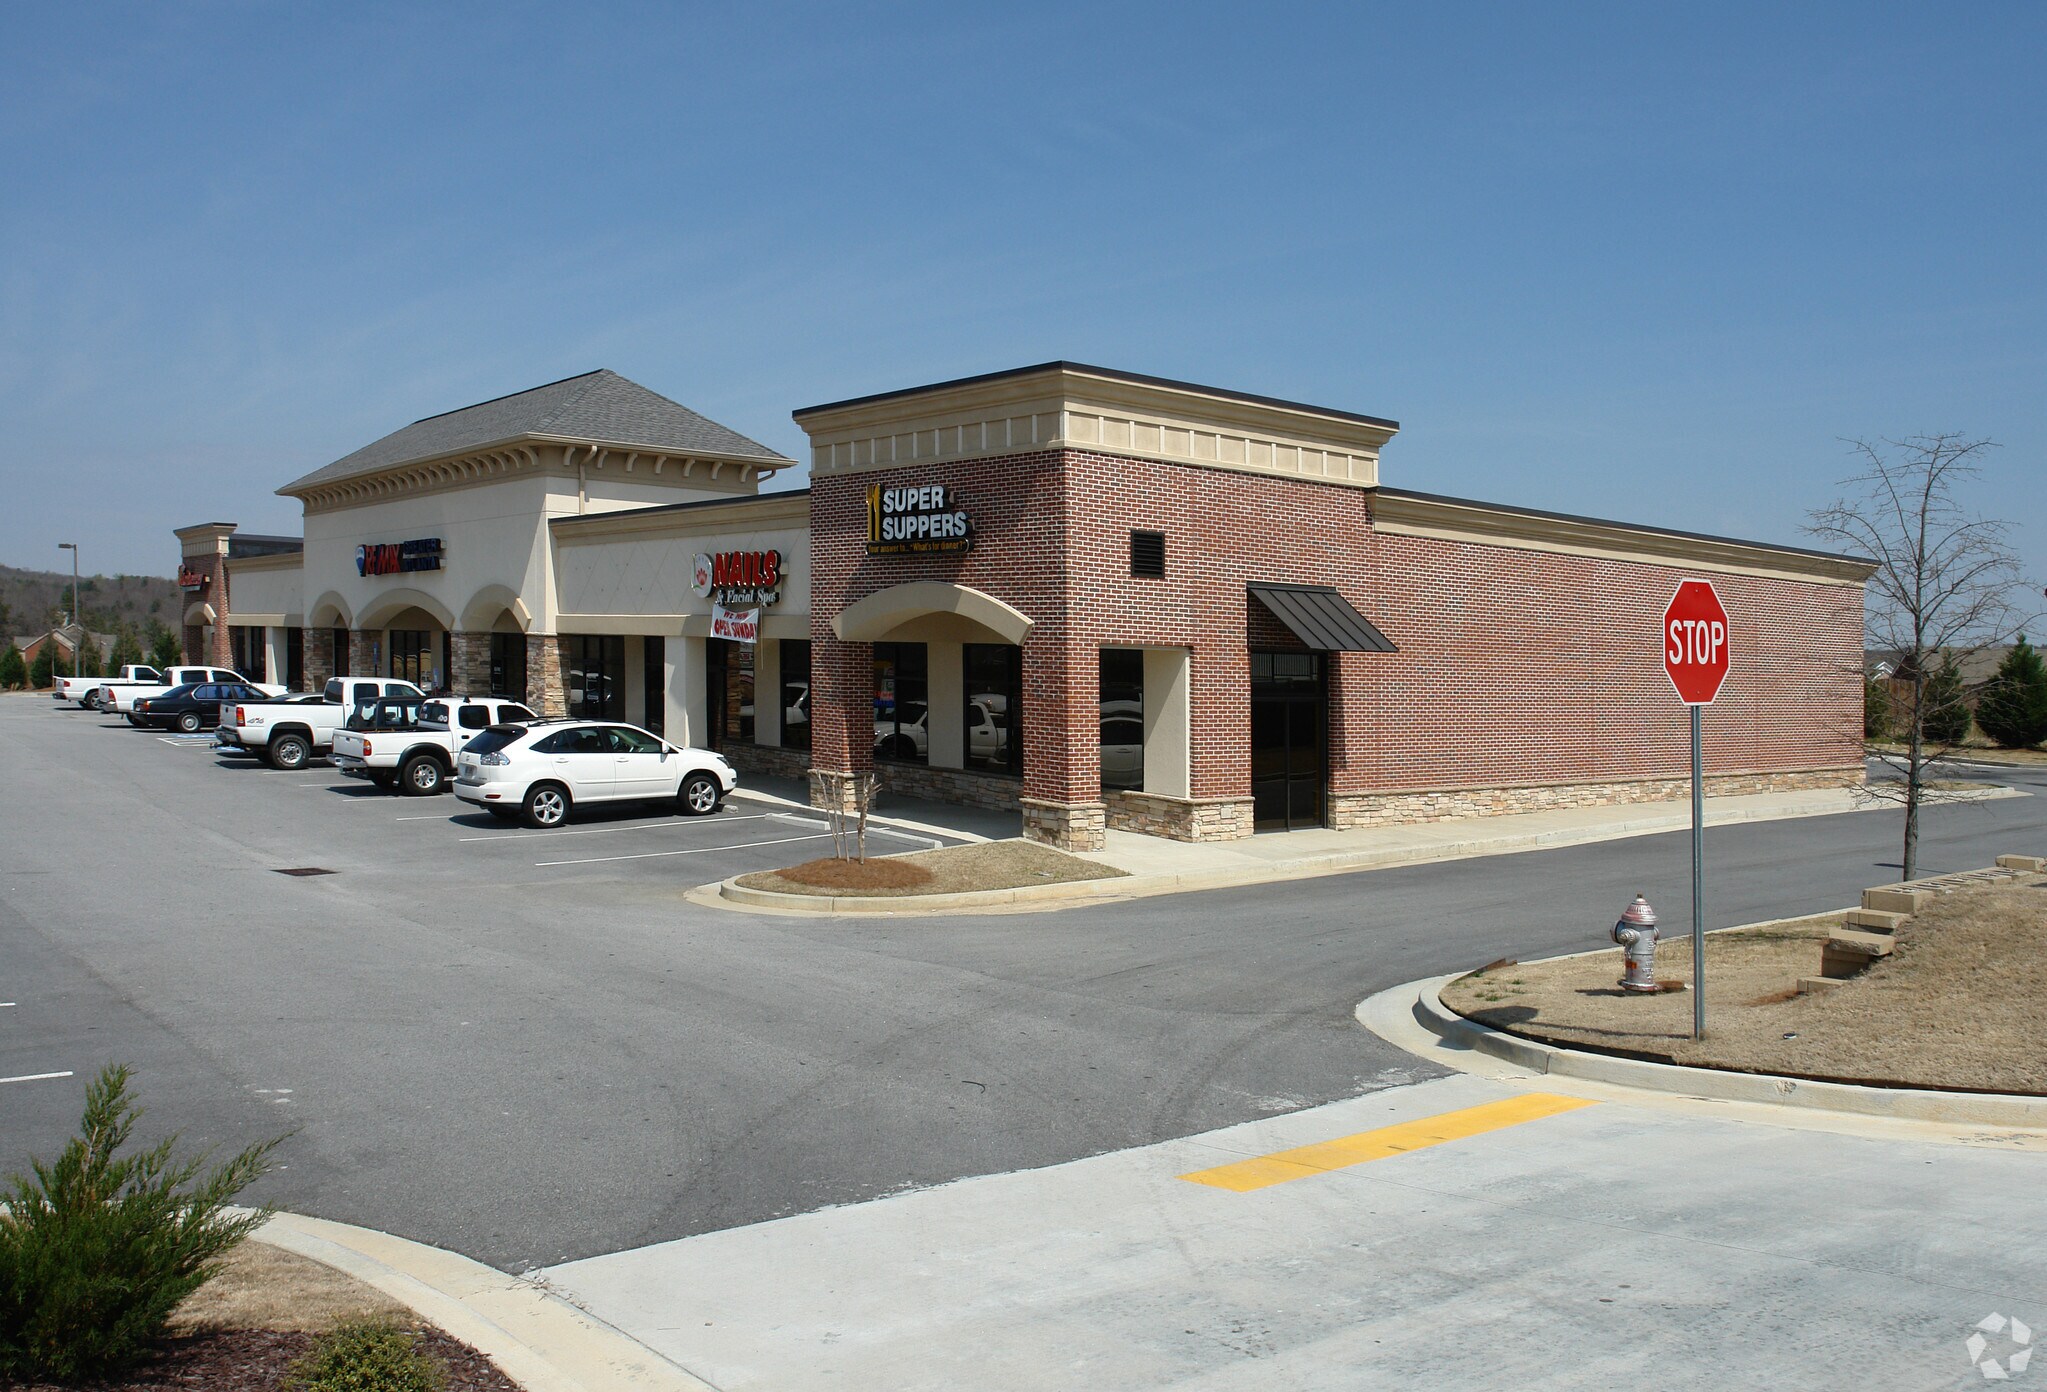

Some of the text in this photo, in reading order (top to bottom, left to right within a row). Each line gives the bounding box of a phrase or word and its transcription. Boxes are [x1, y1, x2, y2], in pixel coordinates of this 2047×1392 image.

[883, 485, 944, 513] SUPER
[882, 511, 967, 540] SUPPERS
[713, 550, 778, 588] NAILS
[716, 588, 725, 605] &
[727, 588, 754, 603] Facial
[714, 618, 731, 636] OPEN
[723, 610, 749, 620] WE NOW
[1669, 619, 1725, 665] STOP
